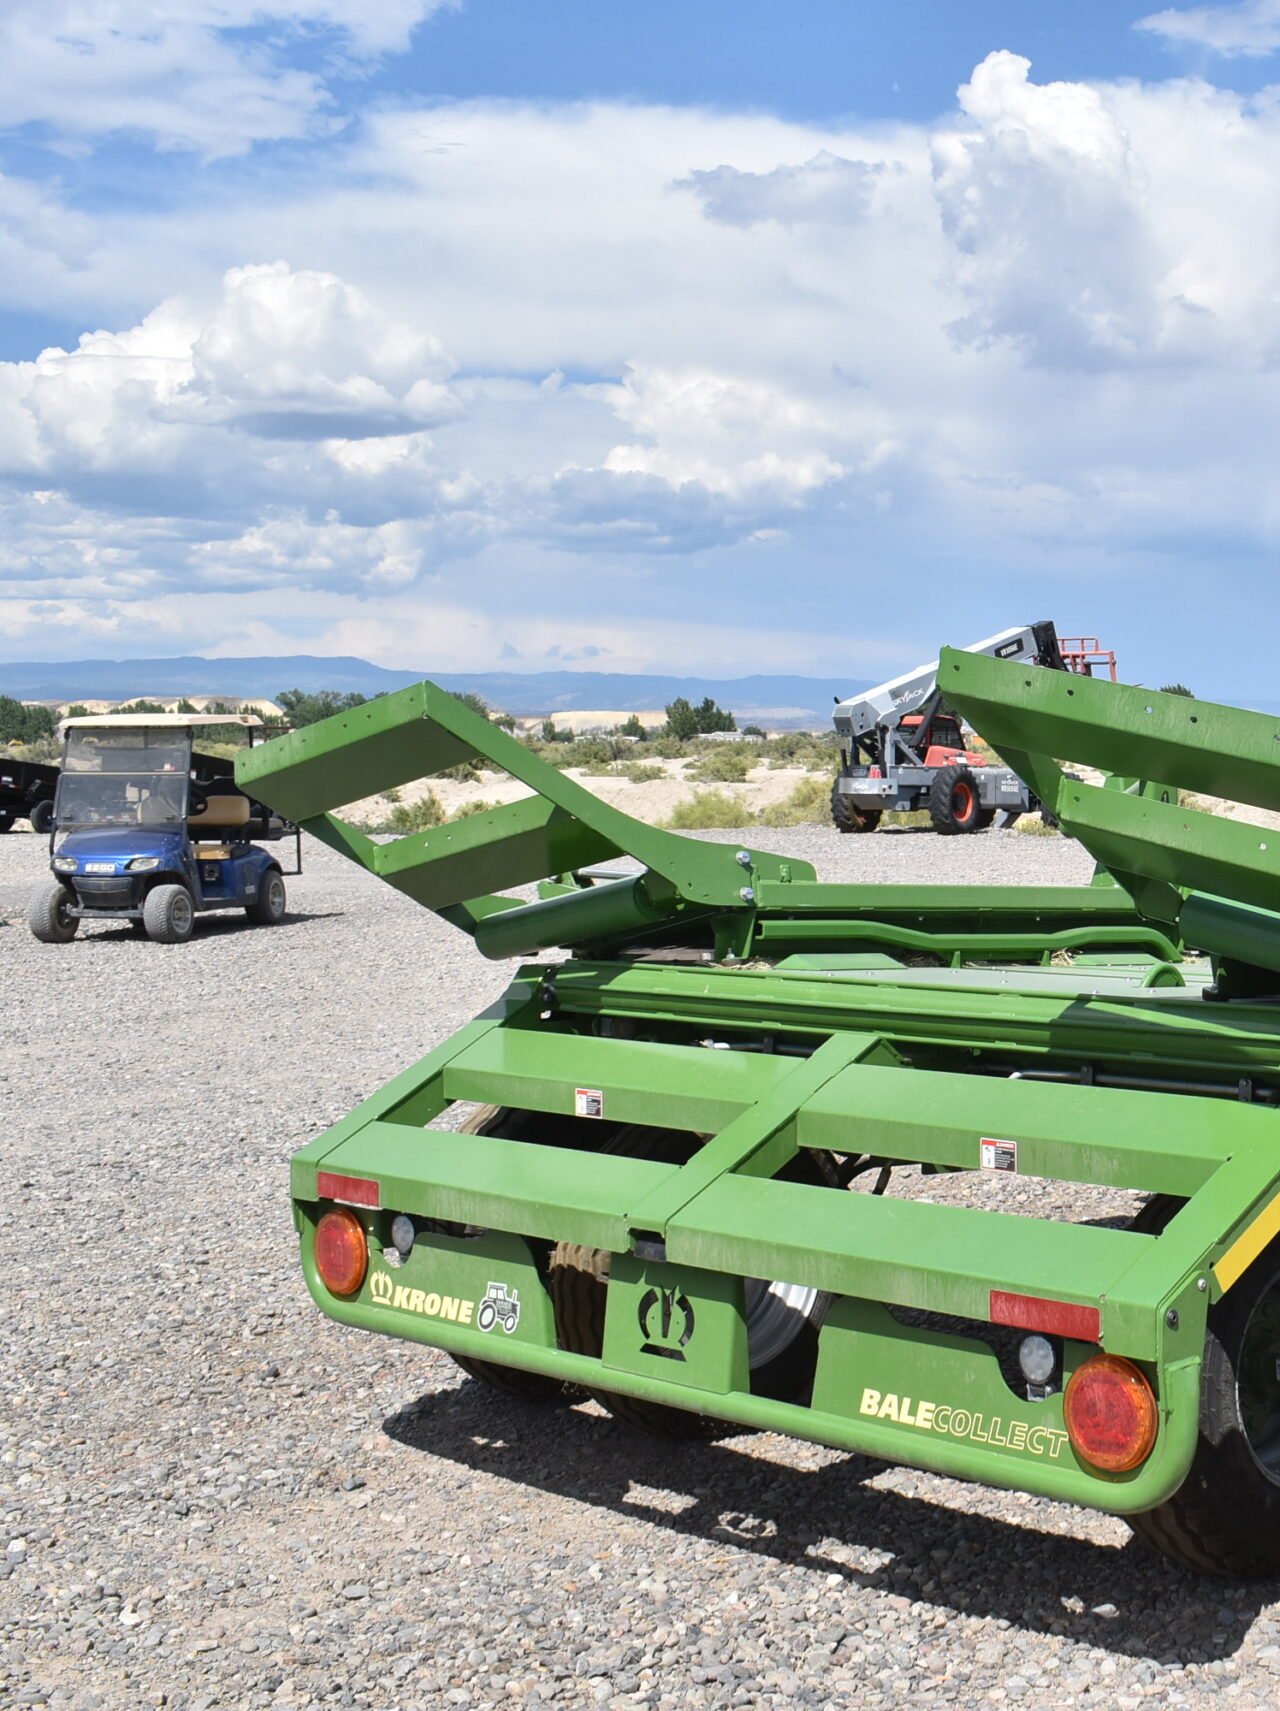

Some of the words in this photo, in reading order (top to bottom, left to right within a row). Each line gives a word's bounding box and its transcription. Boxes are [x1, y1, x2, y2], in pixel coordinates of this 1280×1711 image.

[893, 688, 925, 705] SKYJACK
[393, 1284, 475, 1325] KRONE
[859, 1388, 1069, 1459] BALECOLLECT
